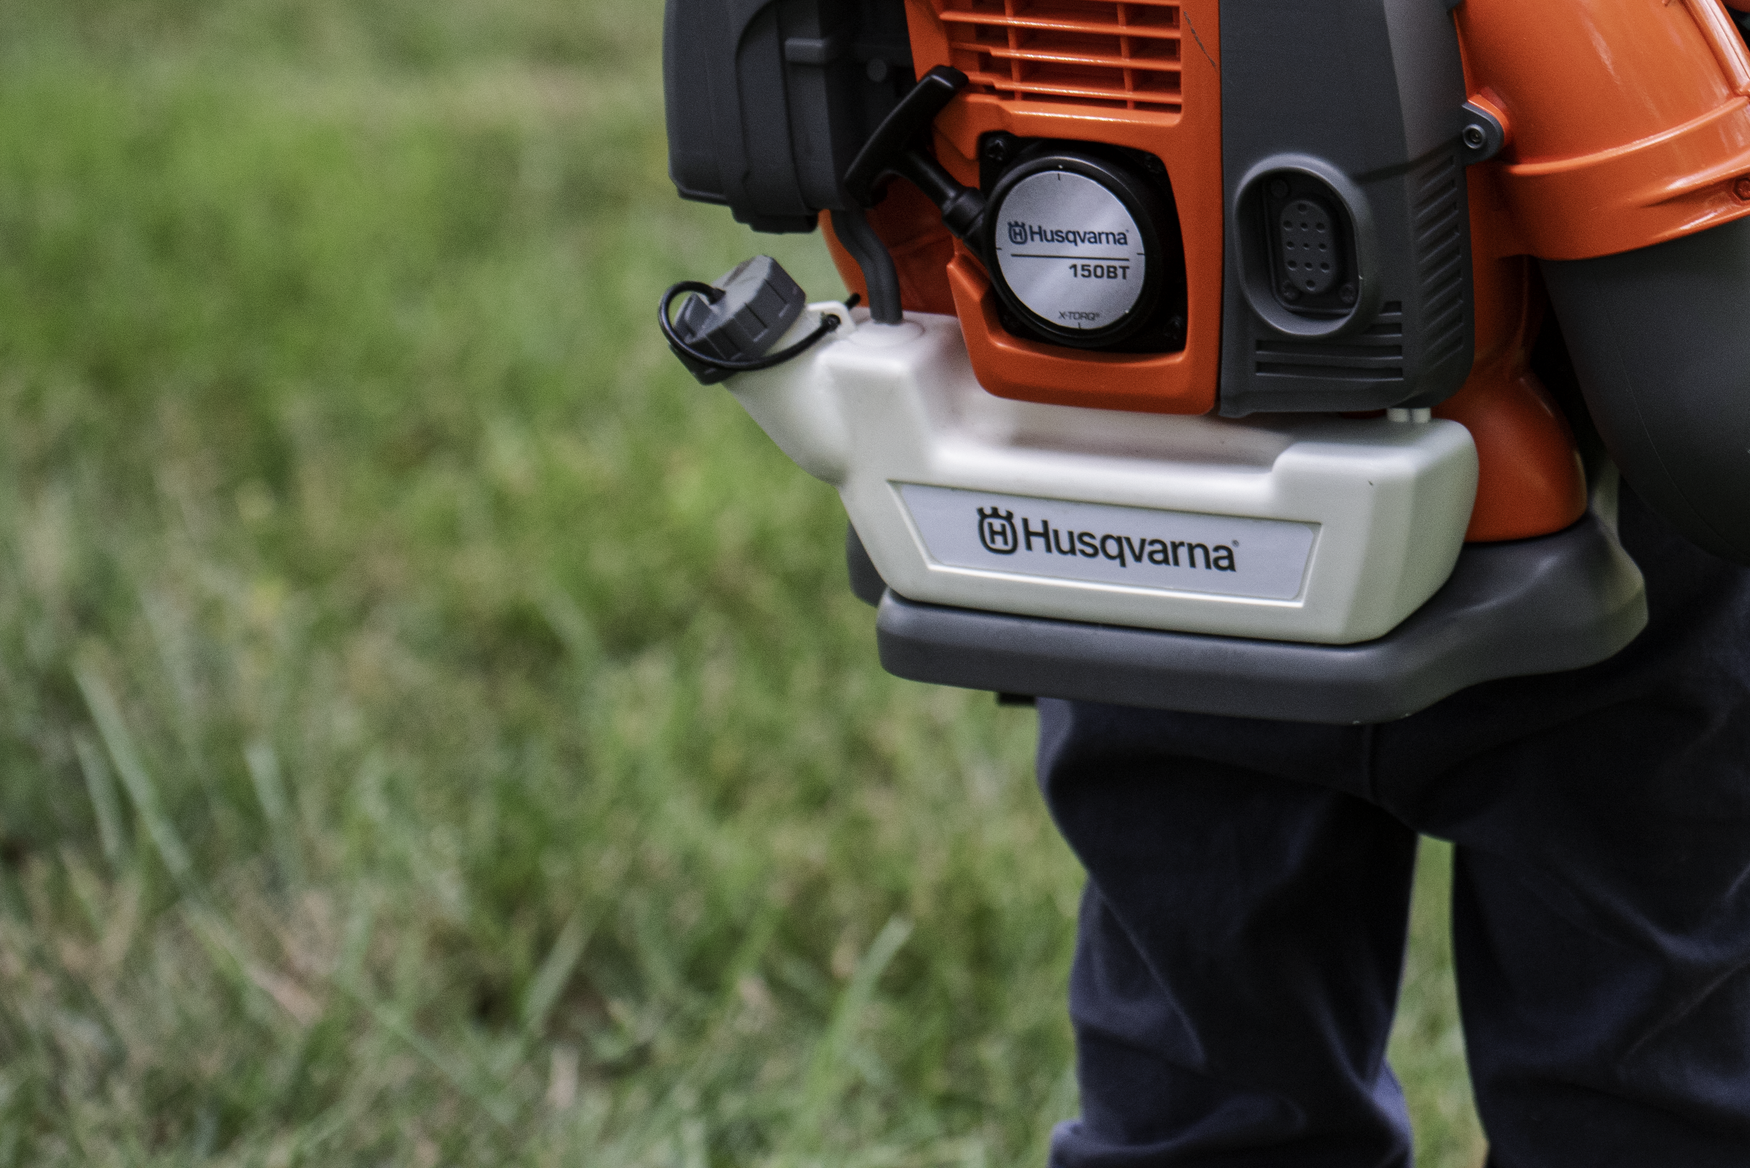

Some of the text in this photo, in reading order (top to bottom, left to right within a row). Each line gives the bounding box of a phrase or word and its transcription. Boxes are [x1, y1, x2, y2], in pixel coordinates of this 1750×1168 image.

[1030, 225, 1128, 247] Husqvarna
[1069, 263, 1130, 280] 150BT
[1021, 517, 1238, 573] Husqvarna
